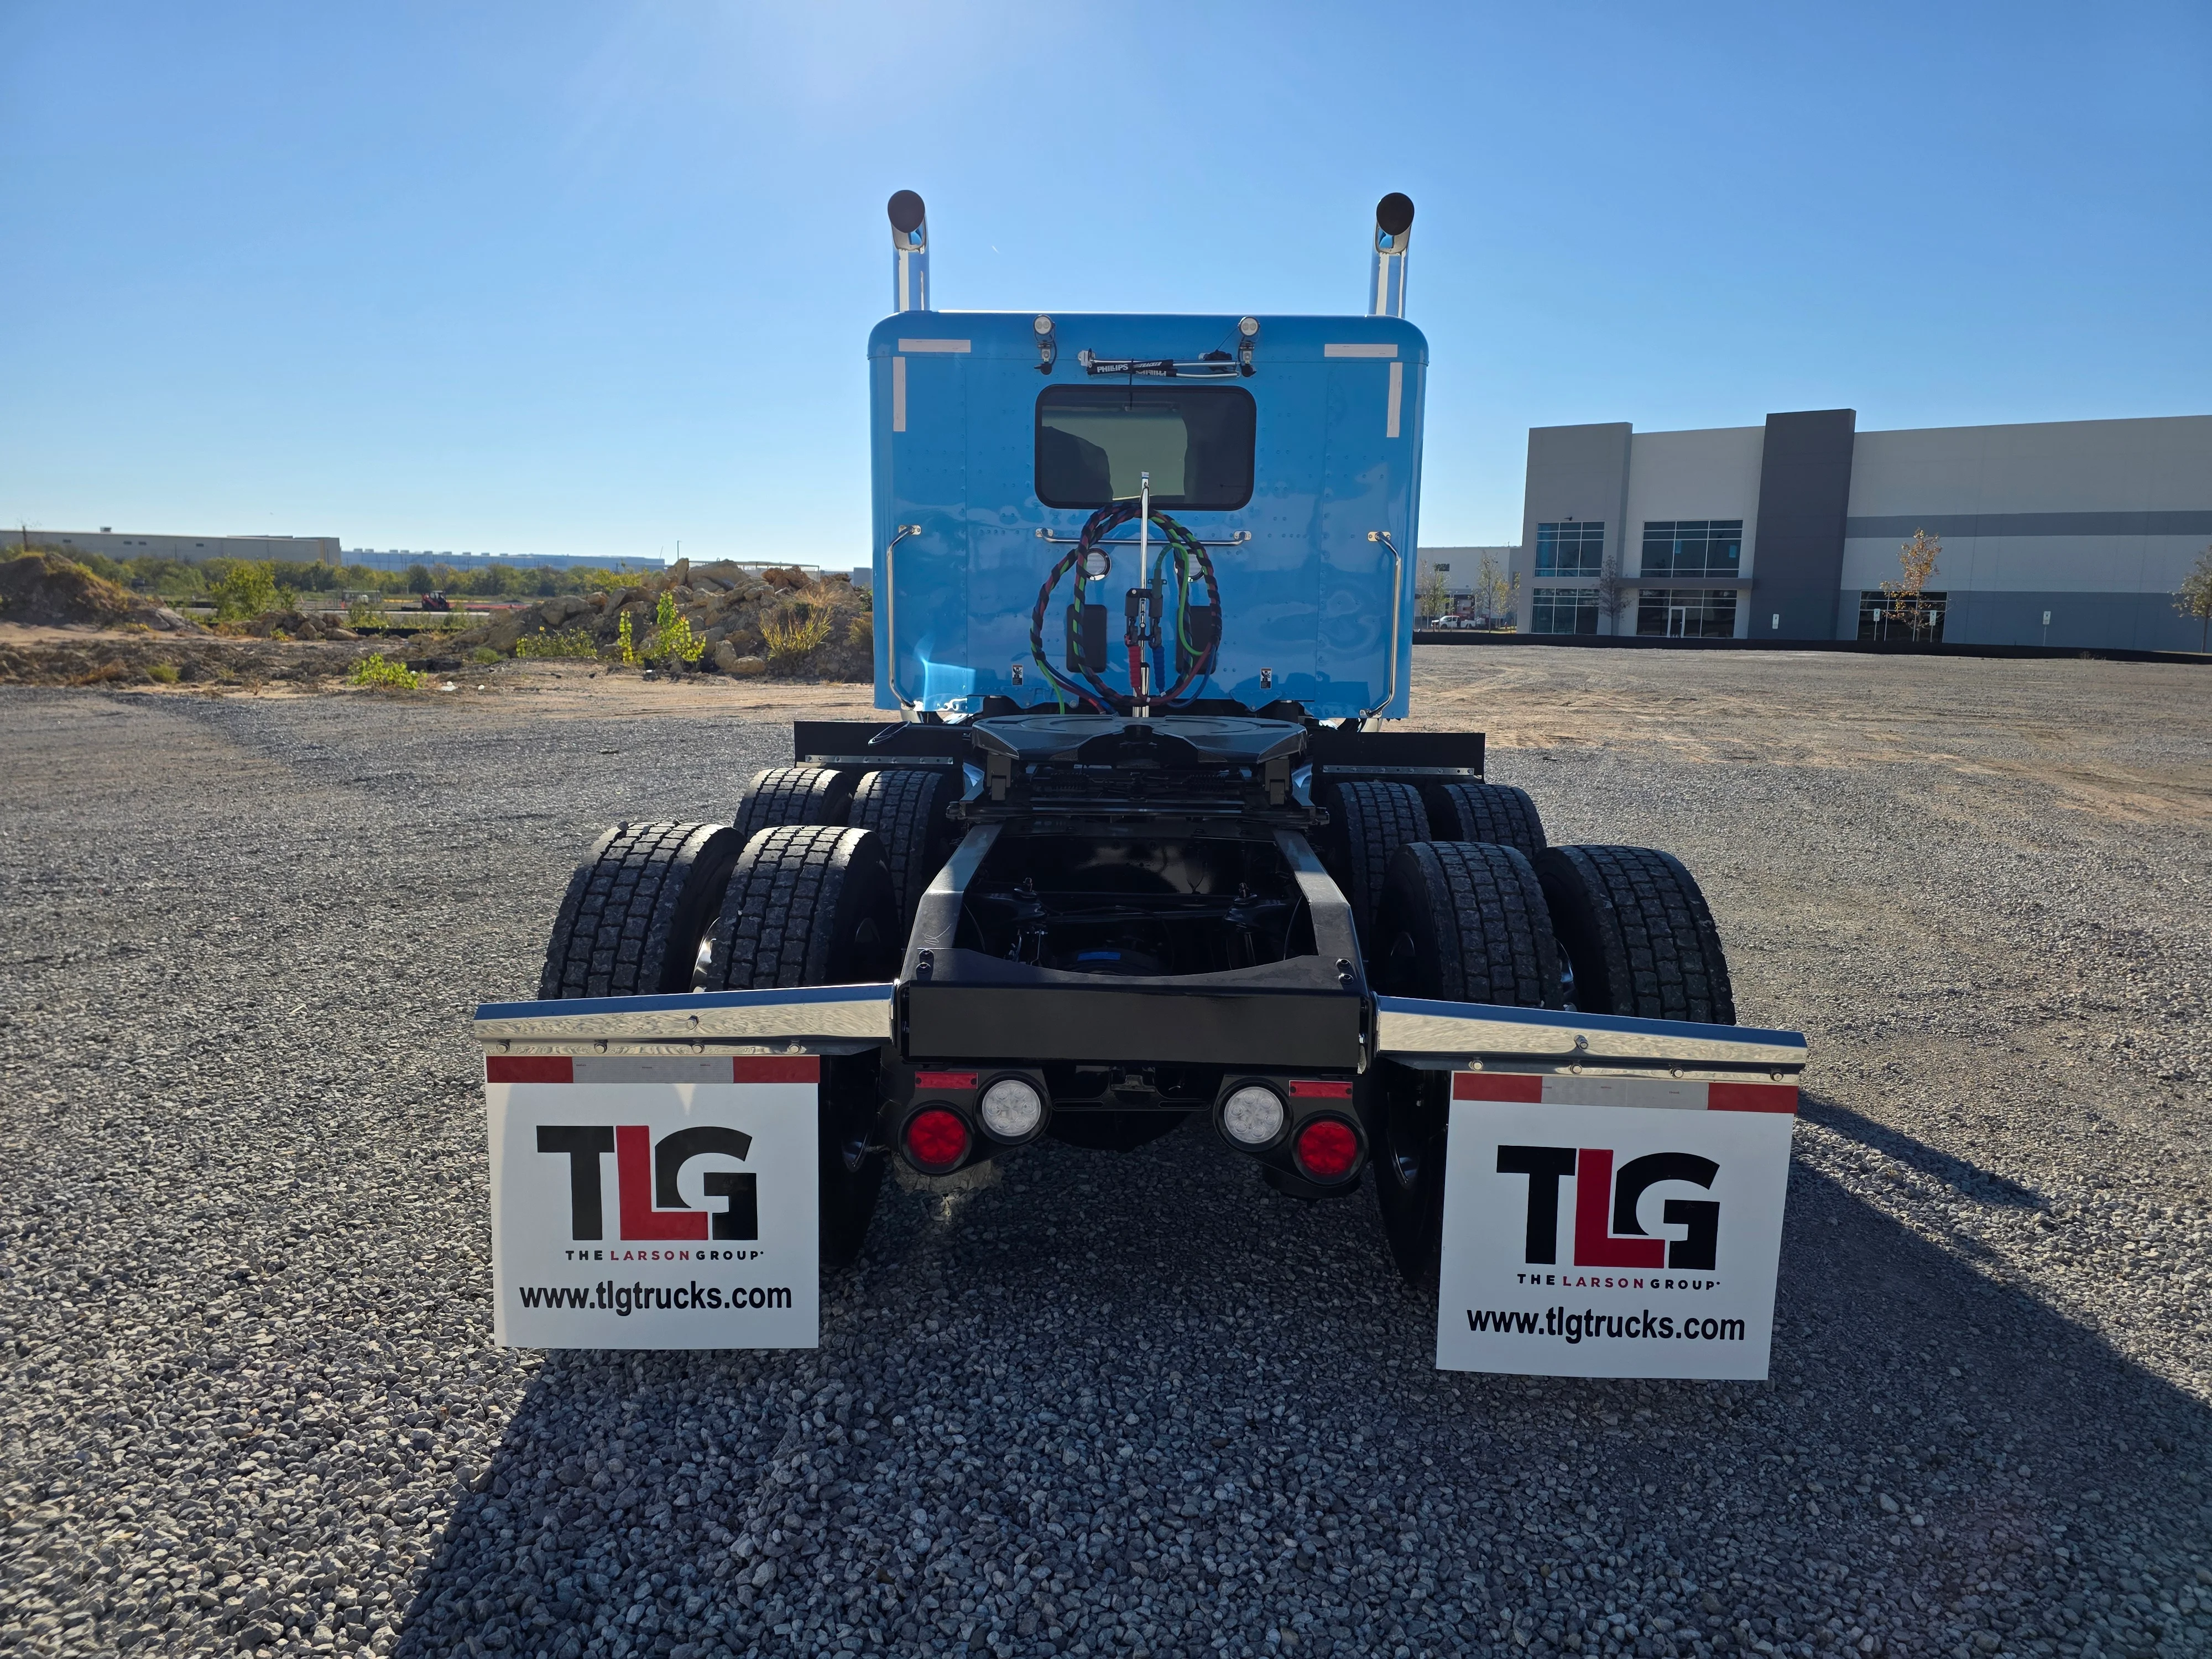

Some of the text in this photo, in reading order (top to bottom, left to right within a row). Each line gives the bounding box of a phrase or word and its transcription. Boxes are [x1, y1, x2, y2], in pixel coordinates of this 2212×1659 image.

[1097, 364, 1129, 373] PHILLIPS
[536, 1125, 758, 1241] TLG
[1496, 1145, 1720, 1271] TLG
[565, 1250, 759, 1261] THE LARSON GROUP
[519, 1280, 792, 1317] www.tlgtrucks.com
[1517, 1273, 1715, 1291] THE LARSON GROUP
[1466, 1306, 1745, 1344] www.tlgtrucks.com
